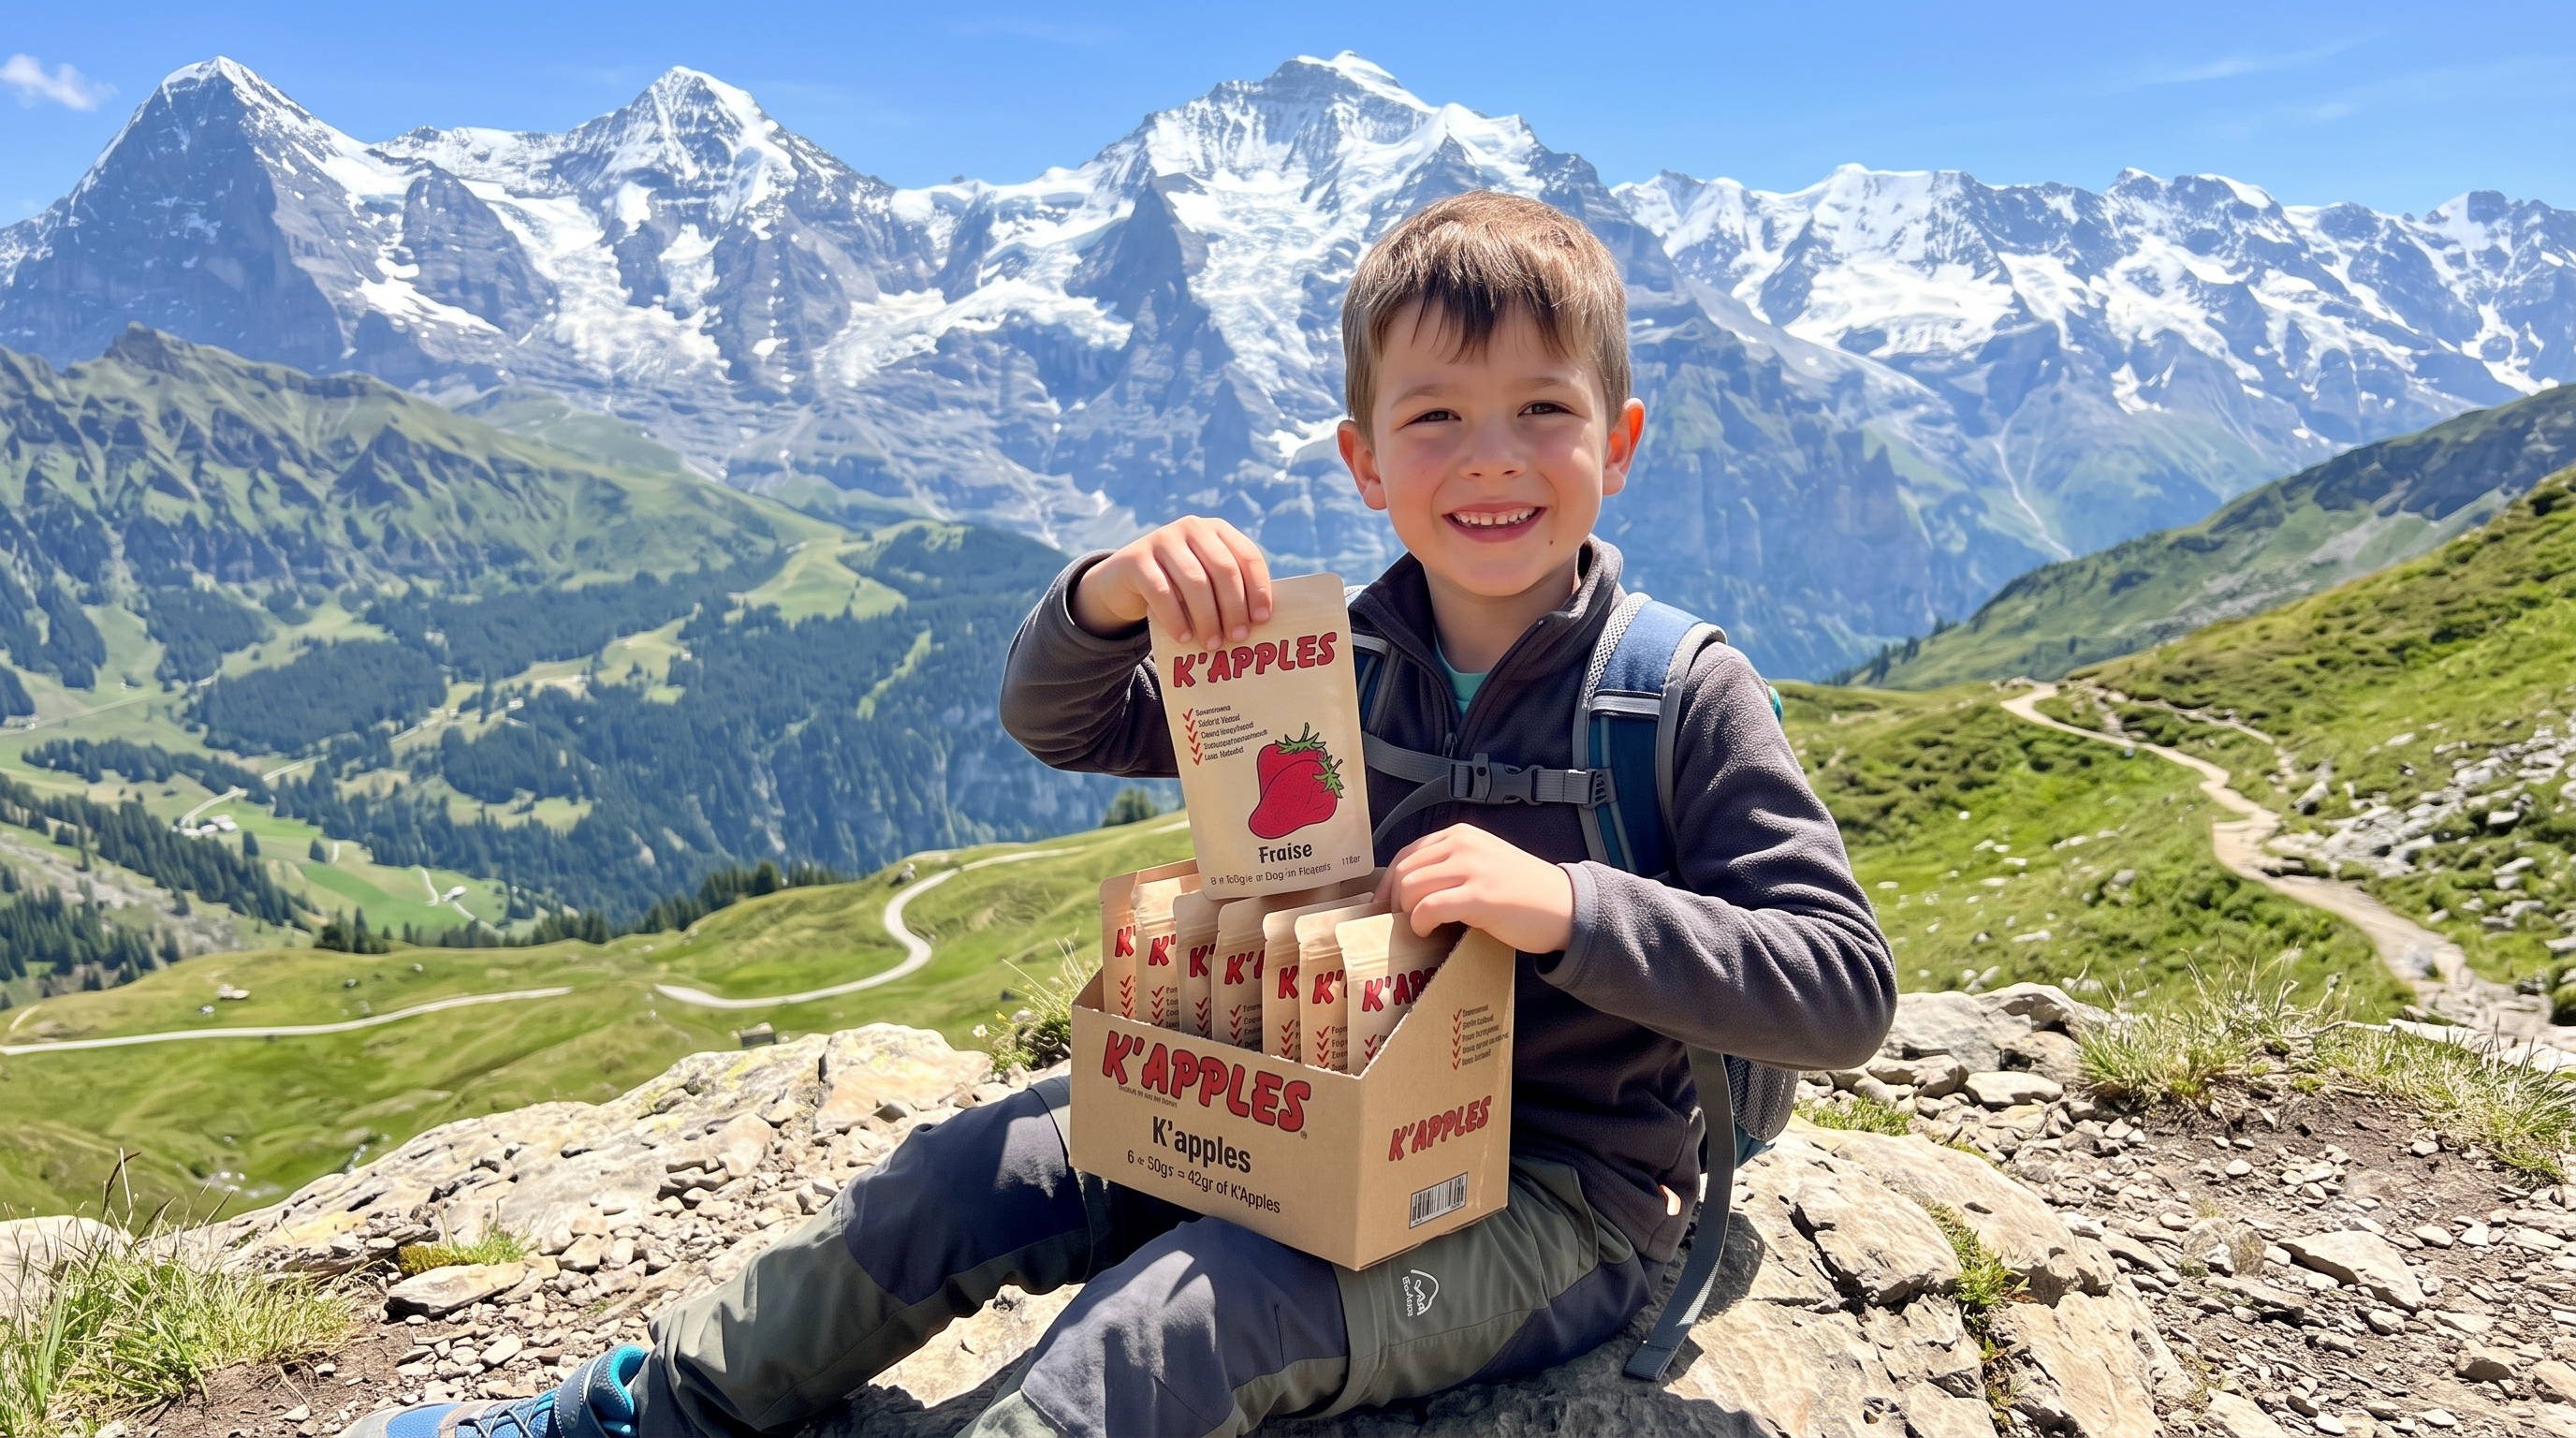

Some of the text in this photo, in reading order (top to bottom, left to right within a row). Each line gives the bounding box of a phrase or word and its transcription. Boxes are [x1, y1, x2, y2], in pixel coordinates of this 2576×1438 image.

[1173, 632, 1338, 688] K'APPLES
[1258, 843, 1313, 864] Fraise
[1102, 1030, 1311, 1132] K'APPLES
[1152, 1115, 1251, 1173] K'apples
[1388, 1095, 1492, 1162] K'APPLES
[1127, 1150, 1134, 1164] 6
[1188, 1170, 1213, 1192] 42gr
[1216, 1180, 1228, 1196] of
[1231, 1183, 1281, 1213] K'Apples
